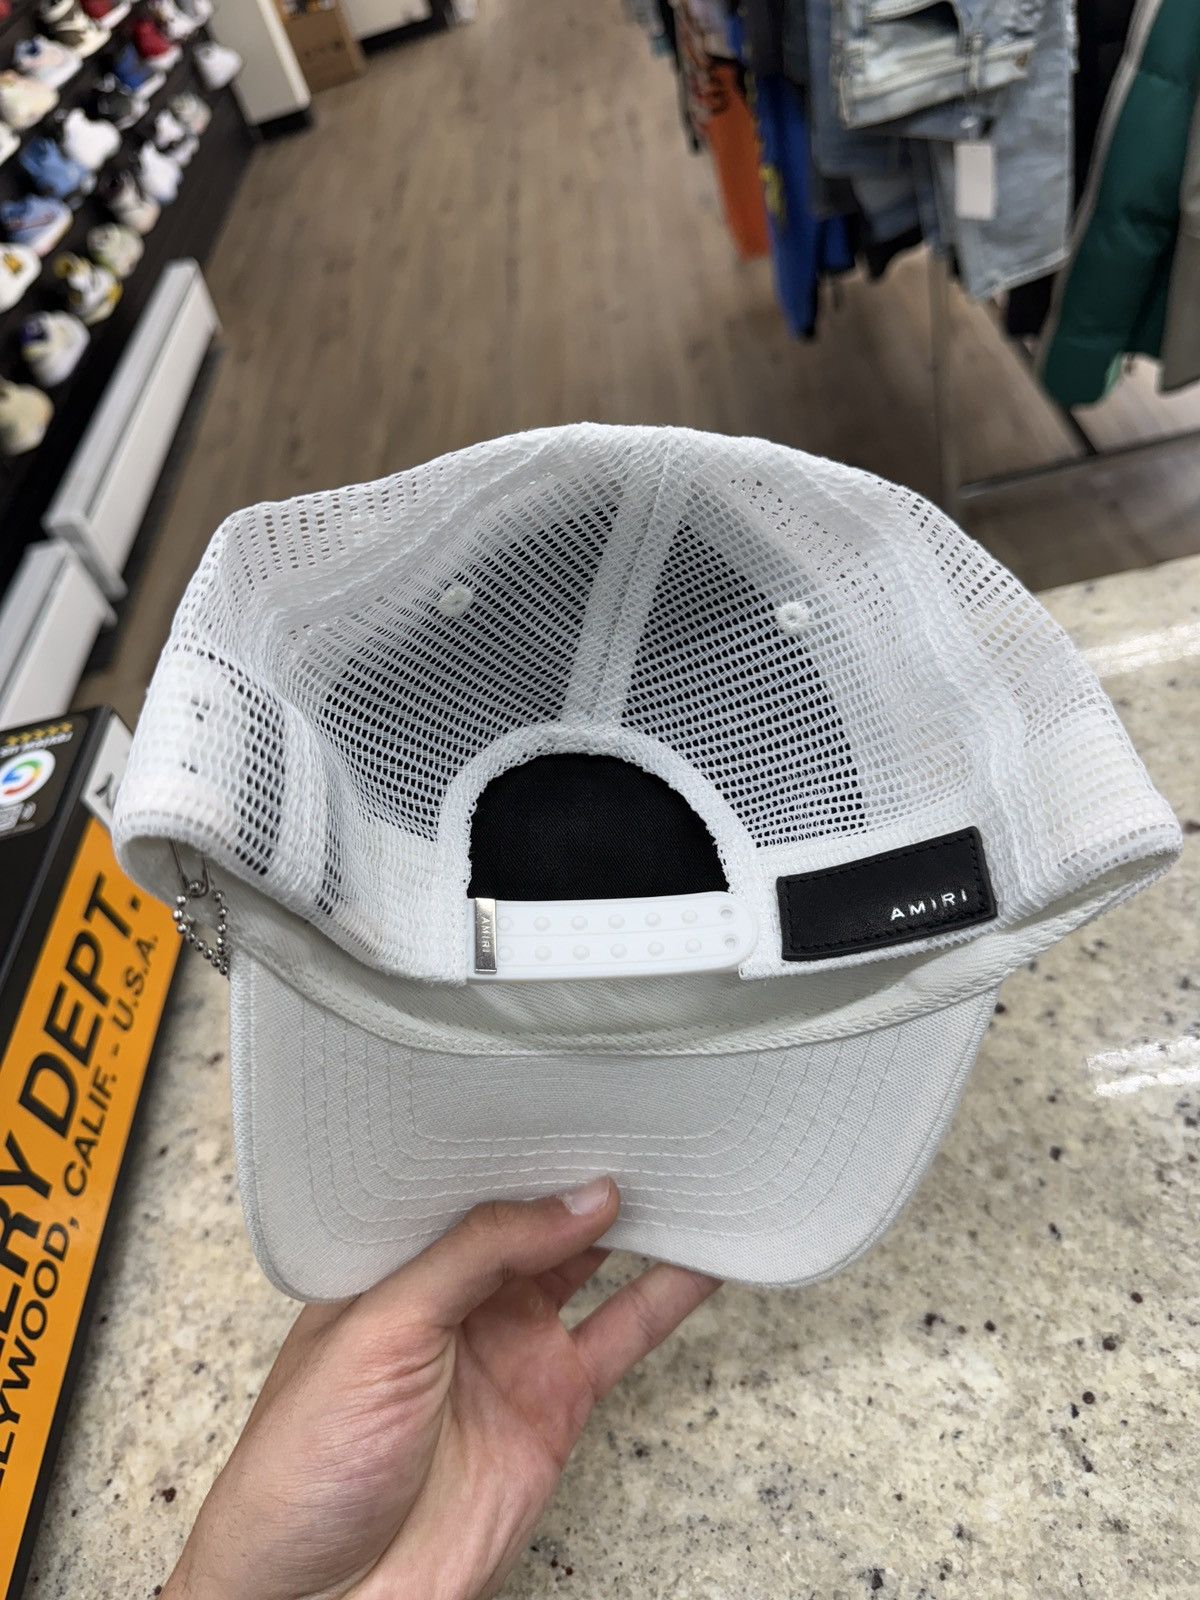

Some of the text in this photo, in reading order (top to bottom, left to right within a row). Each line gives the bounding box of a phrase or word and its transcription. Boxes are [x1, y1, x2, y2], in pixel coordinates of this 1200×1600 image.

[480, 915, 492, 953] AMIRI
[890, 889, 967, 920] AMIRI
[18, 870, 141, 1139] DEPT.
[63, 1064, 117, 1197] CALIF.
[111, 934, 158, 1032] U.S.A.
